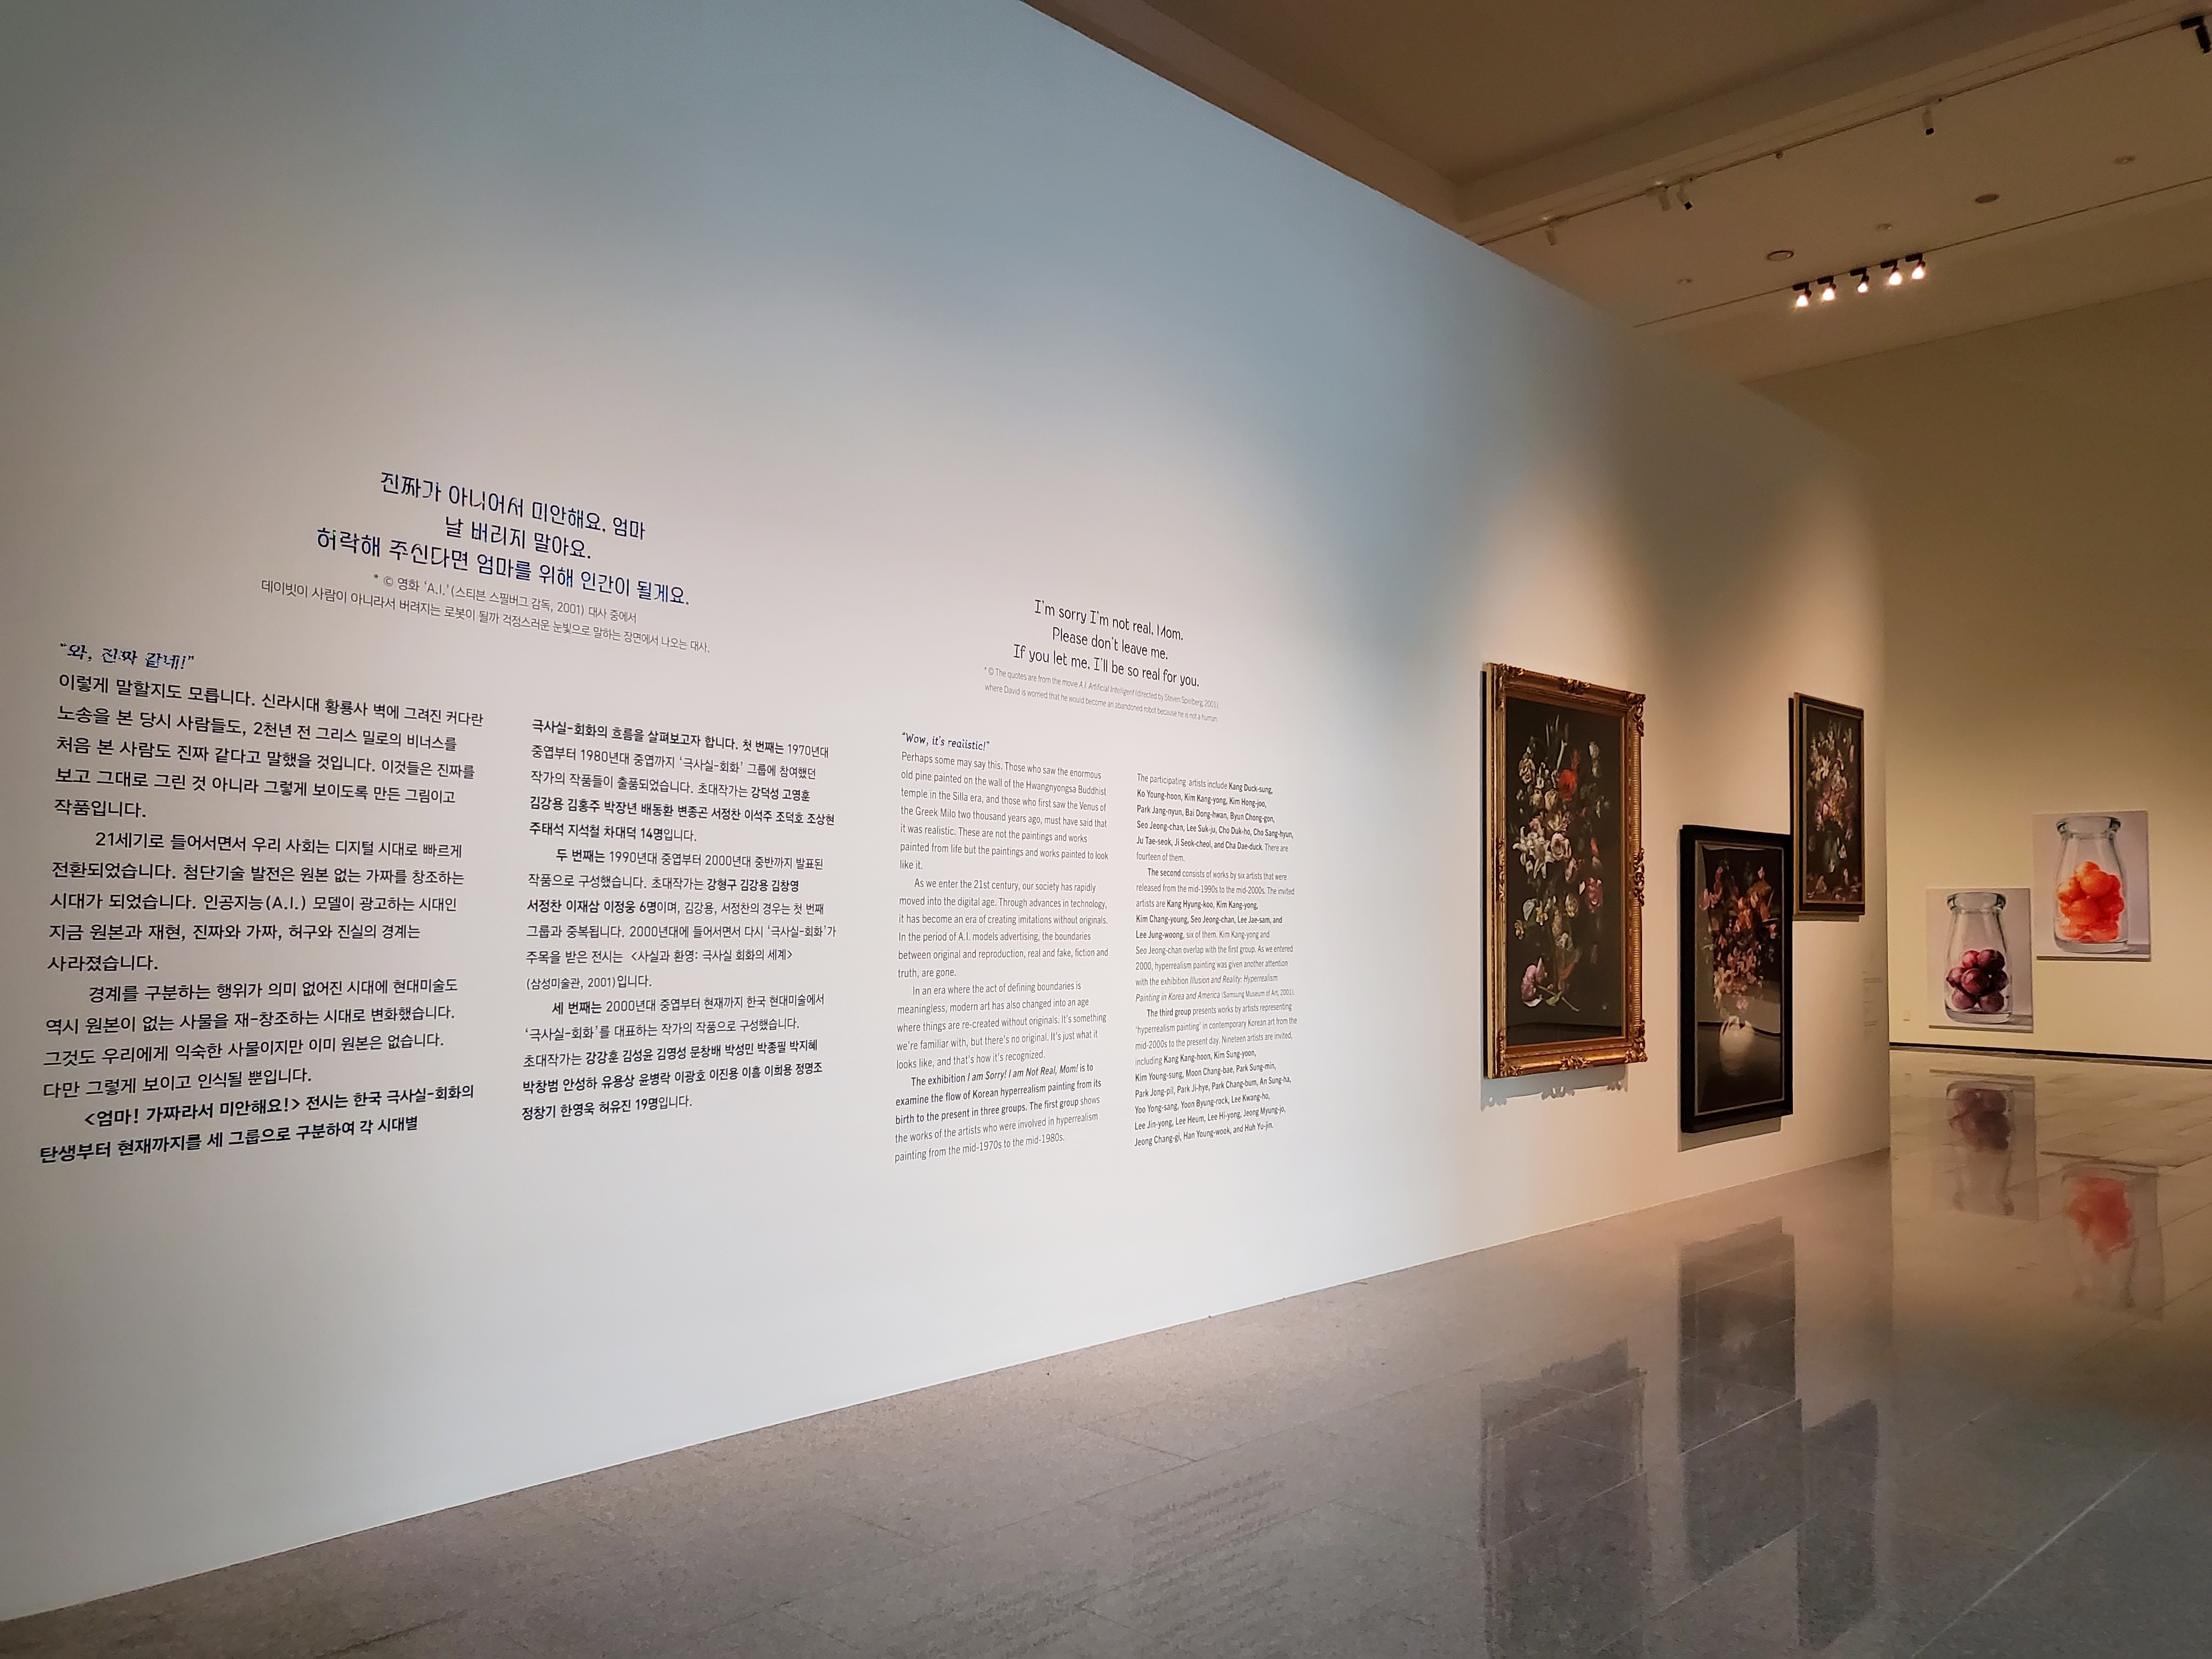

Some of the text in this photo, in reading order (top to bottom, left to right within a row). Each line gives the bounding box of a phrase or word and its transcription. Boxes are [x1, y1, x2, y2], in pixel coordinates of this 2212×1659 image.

[380, 471, 442, 503] 진짜가
[449, 485, 523, 518] 아니어서
[613, 517, 646, 540] 엄마
[445, 516, 591, 560] 날 버리지 말아요.
[317, 527, 689, 606] 허락해 주신다면 엄마를 위해 인간이 될게요.
[261, 579, 710, 653] 데이빗이 사람이 아니라서 버려지는 로봇이 될까 걱정스러운 눈빛으로 말하는 장면에서 나오는 대사.
[397, 577, 420, 592] 영화
[488, 591, 529, 607] 스필버그
[531, 597, 554, 613] 감독,
[557, 601, 584, 617] 2001)
[588, 606, 607, 619] 대사
[610, 609, 636, 624] 중에서
[1034, 599, 1055, 617] I'm
[1058, 608, 1087, 624] sorry
[1090, 610, 1109, 627] I'm
[1112, 618, 1130, 631] not
[1157, 623, 1183, 641] Mom.
[100, 648, 138, 666] 진짜
[1052, 627, 1168, 660] Please don't leave me.
[1013, 644, 1026, 659] If
[1029, 650, 1049, 663] you
[1053, 650, 1068, 666] let
[1093, 657, 1108, 673] I'll
[1111, 659, 1124, 675] be
[1127, 667, 1139, 678] so
[1142, 667, 1160, 681] real
[1163, 669, 1177, 684] for
[1180, 675, 1199, 687] you.
[59, 674, 484, 727] 이렇게 말할지도 모릅니다. 신라시대 황룡사 벽에 그려진 커다란
[611, 726, 645, 742] 흐름을
[647, 730, 701, 747] 살펴보고자
[704, 735, 738, 751] 합니다.
[742, 739, 752, 752] 첫
[755, 740, 785, 755] 번째는
[787, 743, 829, 759] 1970년대
[932, 735, 945, 746] it's
[901, 751, 1102, 780] Perhaps some may say this. Those who saw the enormous
[1137, 773, 1273, 795] The participating artists include Kang Duck-sung,
[54, 799, 146, 818] 작품입니다.
[530, 796, 834, 826] 김강용 김홍주 박장년 배동환 변종곤 서정찬 이석주 조덕호 조상현
[95, 832, 462, 859] 21세기로 들어서면서 우리 사회는 디지털 시대로 빠르게
[529, 821, 697, 842] 주태석 지석철 차대덕 14명입니다.
[556, 848, 823, 870] 두 번째는 1990년대 중엽부터 2000년대 중반까지 발표된
[89, 978, 458, 1003] 경계를 구분하는 행위가 의미 없어진 시대에 현대미술도
[1135, 1075, 1291, 1098] Park Jong-pil, Park Ji-hye, Park Chang-bum, An Sung-ha,
[521, 1094, 692, 1121] 정창기 한영욱 허유진 19명입니다.
[40, 1115, 417, 1164] 탄생부터 현재까지를 세 그룹으로 구분하여 각 시대별
[894, 1132, 1065, 1164] painting from the mid-1970s to the mid-1980s.
